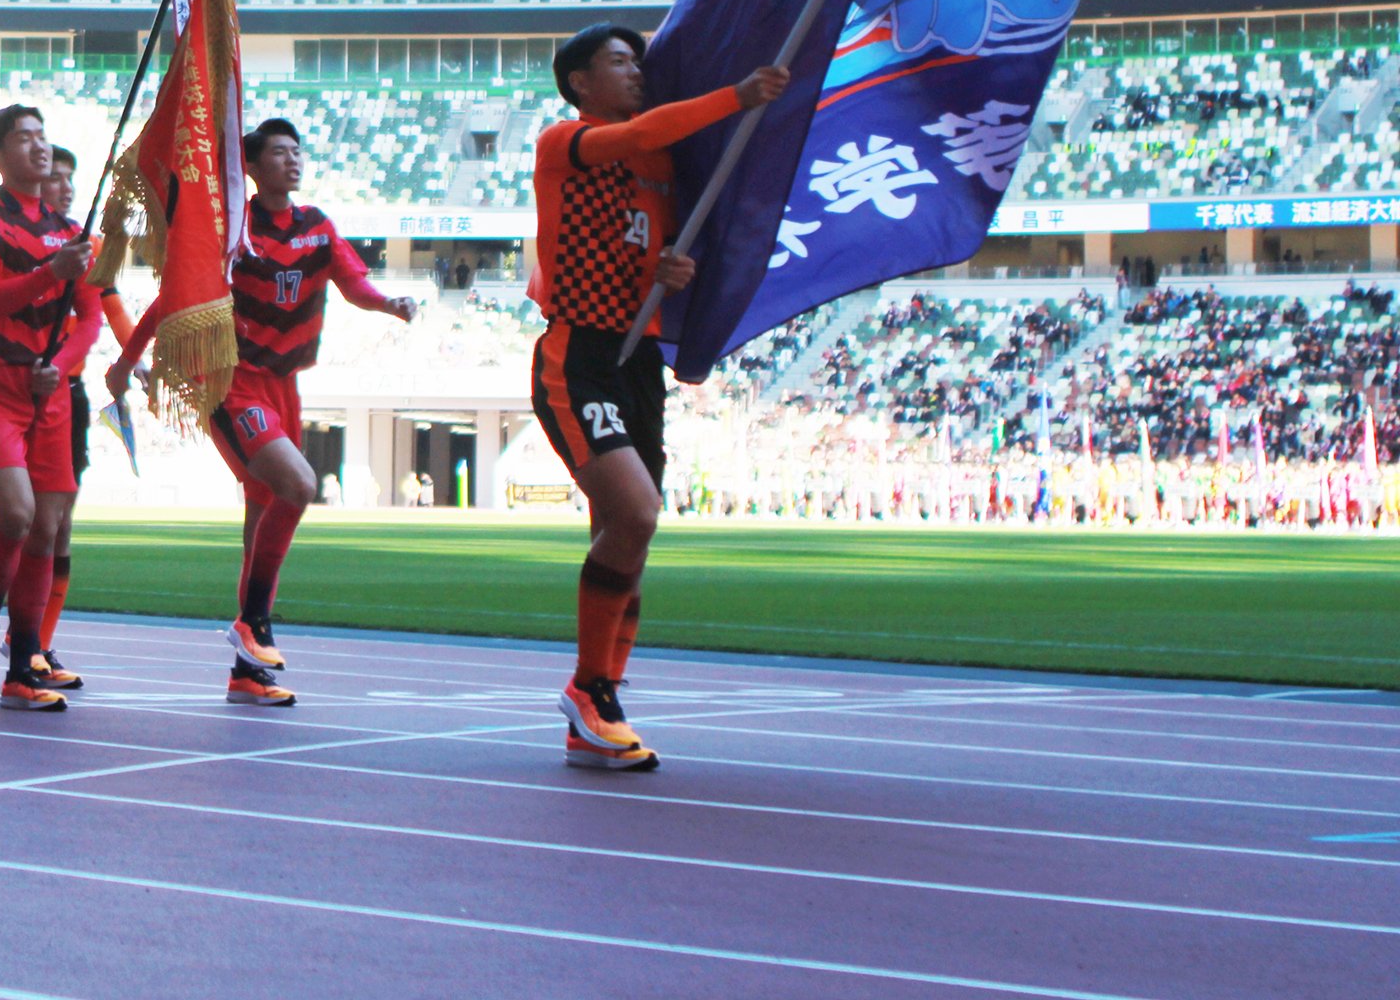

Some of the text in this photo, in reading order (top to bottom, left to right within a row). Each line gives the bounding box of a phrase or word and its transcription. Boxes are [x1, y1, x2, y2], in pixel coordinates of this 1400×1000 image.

[399, 216, 473, 234] 前橋育英
[624, 210, 649, 249] 29
[1195, 203, 1275, 227] 千葉代表
[275, 270, 303, 304] 17
[237, 406, 268, 440] 17
